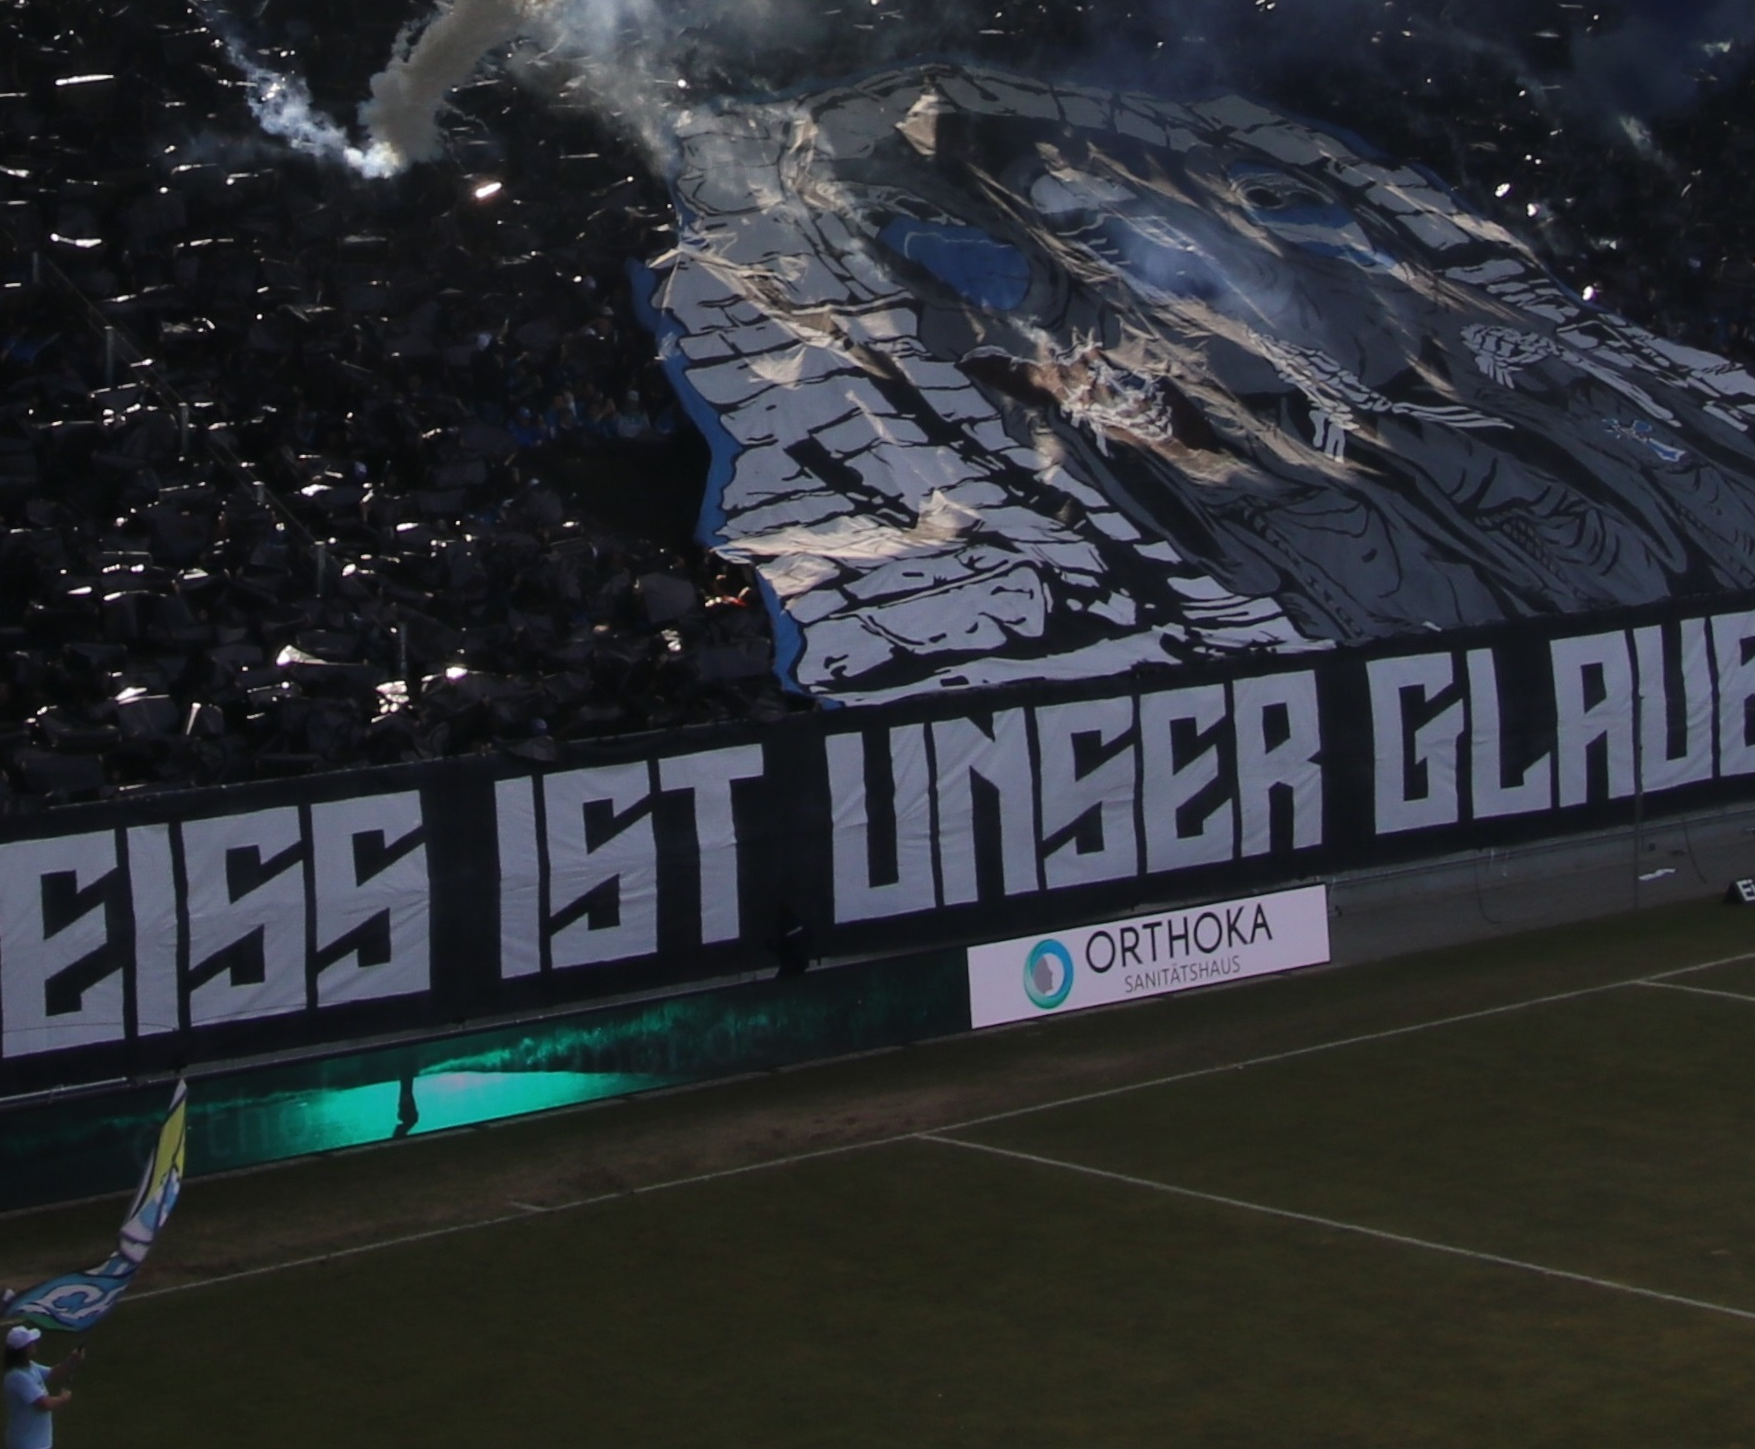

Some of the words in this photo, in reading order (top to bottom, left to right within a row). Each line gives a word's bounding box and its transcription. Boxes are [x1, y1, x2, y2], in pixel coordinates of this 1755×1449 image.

[495, 744, 764, 979] IST
[825, 669, 1322, 924] UNSER
[1085, 903, 1273, 973] ORTHOKA
[1124, 954, 1241, 993] SANITÄTSHAUS
